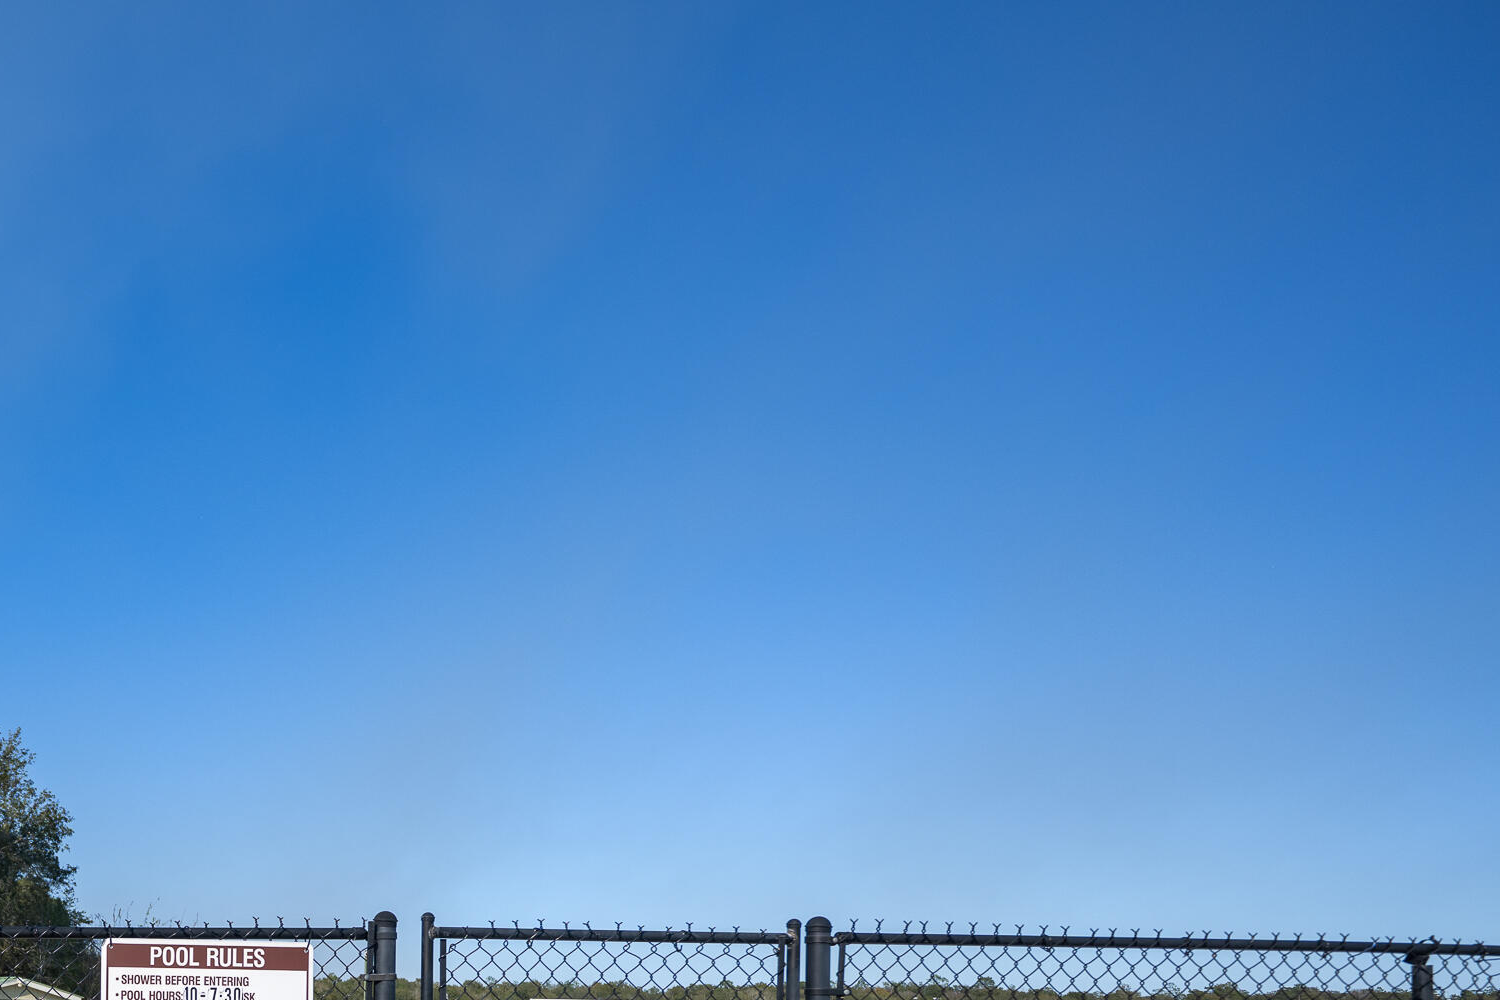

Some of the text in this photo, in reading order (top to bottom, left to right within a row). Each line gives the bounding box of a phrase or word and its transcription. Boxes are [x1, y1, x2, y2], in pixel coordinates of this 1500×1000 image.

[149, 946, 266, 968] POOL RULES
[121, 975, 250, 987] SHOWER BEFORE ENTERING
[120, 990, 145, 1000] POOL
